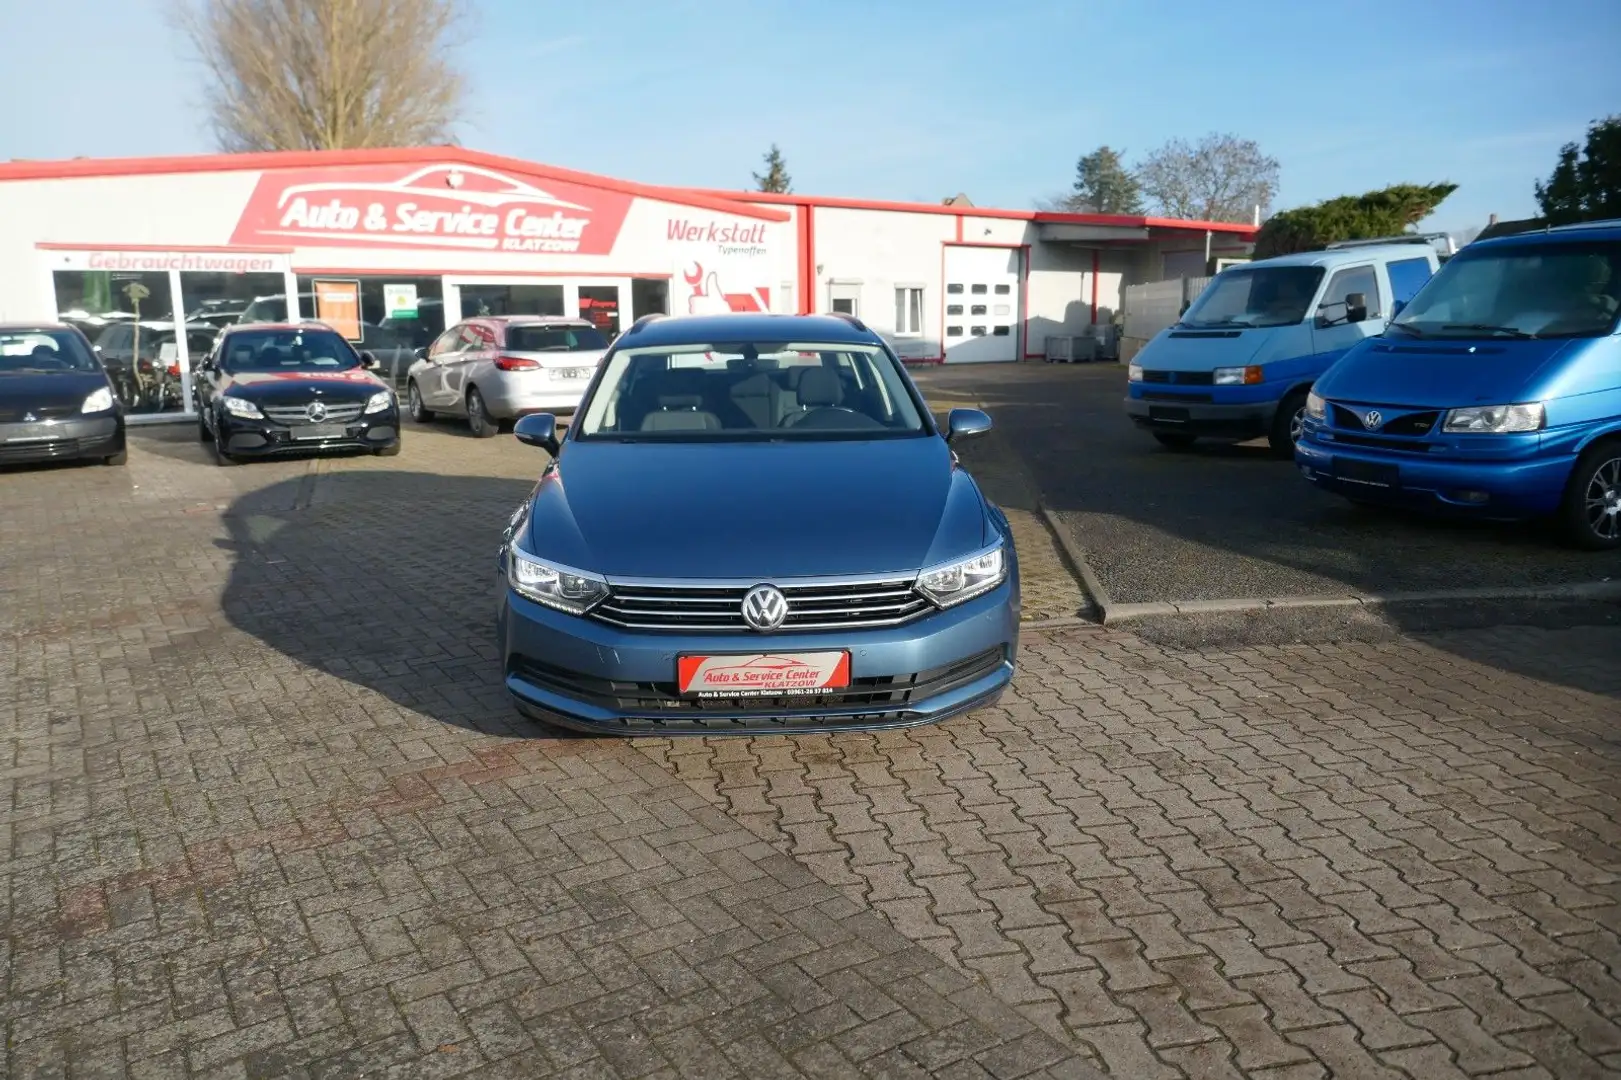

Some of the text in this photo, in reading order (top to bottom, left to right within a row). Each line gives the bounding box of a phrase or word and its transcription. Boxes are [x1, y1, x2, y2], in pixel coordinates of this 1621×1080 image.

[280, 197, 590, 241] Auto & Service Center
[667, 218, 765, 243] Werkstatt
[717, 244, 767, 257] Typenoffen
[88, 252, 274, 274] Gebrauchtwagen
[704, 669, 820, 683] Auto & Service Center
[764, 679, 816, 688] KLATZOW
[719, 690, 740, 698] Service
[740, 689, 760, 697] Center
